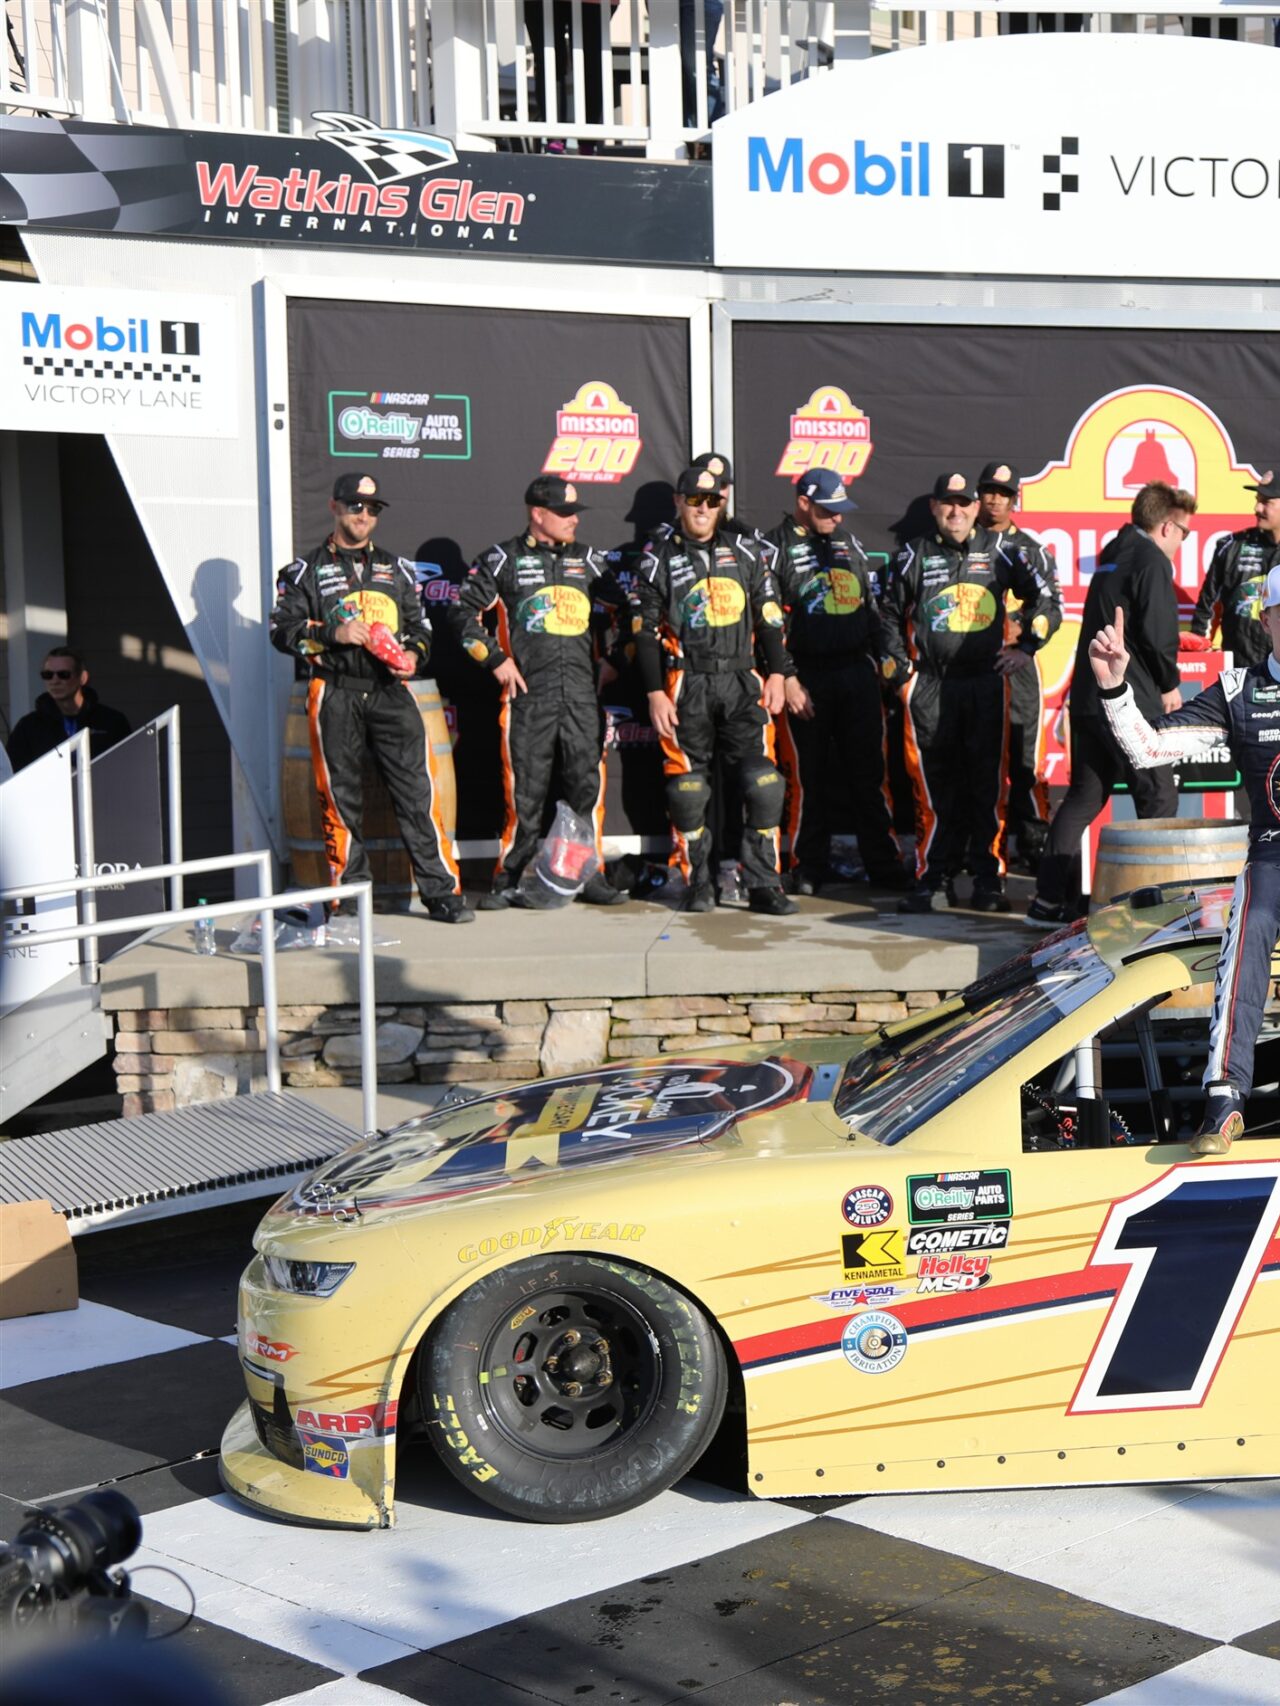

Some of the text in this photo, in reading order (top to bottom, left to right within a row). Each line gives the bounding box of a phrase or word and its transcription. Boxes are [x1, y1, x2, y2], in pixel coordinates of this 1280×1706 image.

[748, 136, 929, 196] Mobil
[195, 161, 525, 225] Watkins Glen
[204, 210, 518, 241] INTERNATIONAL
[21, 312, 149, 353] Mobil
[25, 384, 202, 409] VICTORY LANE
[384, 392, 430, 405] NASCAR
[341, 408, 459, 441] O'Reilly AUTO
[421, 428, 463, 440] PARTS
[382, 447, 421, 458] SERIES
[543, 438, 641, 472] 200
[777, 442, 873, 475] 200
[582, 1074, 665, 1139] JOCKEY
[948, 1171, 980, 1181] NASCAR
[848, 1187, 885, 1204] NASCAR
[856, 1202, 880, 1211] 250
[915, 1185, 1002, 1210] O'Reilly AUTO
[975, 1194, 1005, 1205] PARTS
[848, 1210, 888, 1225] SALUTES
[947, 1212, 975, 1222] SERIES
[457, 1216, 647, 1263] GOODYEAR
[910, 1226, 1007, 1250] COMETIC
[844, 1269, 903, 1281] KENNAMETAL
[918, 1253, 991, 1278] Holley
[831, 1286, 894, 1300] FIVE STAR
[917, 1275, 981, 1293] MSD
[848, 1314, 899, 1335] CHAMPION
[850, 1347, 902, 1371] IRRIGATION
[297, 1409, 372, 1434] ARP
[304, 1446, 347, 1463] SUNOCO
